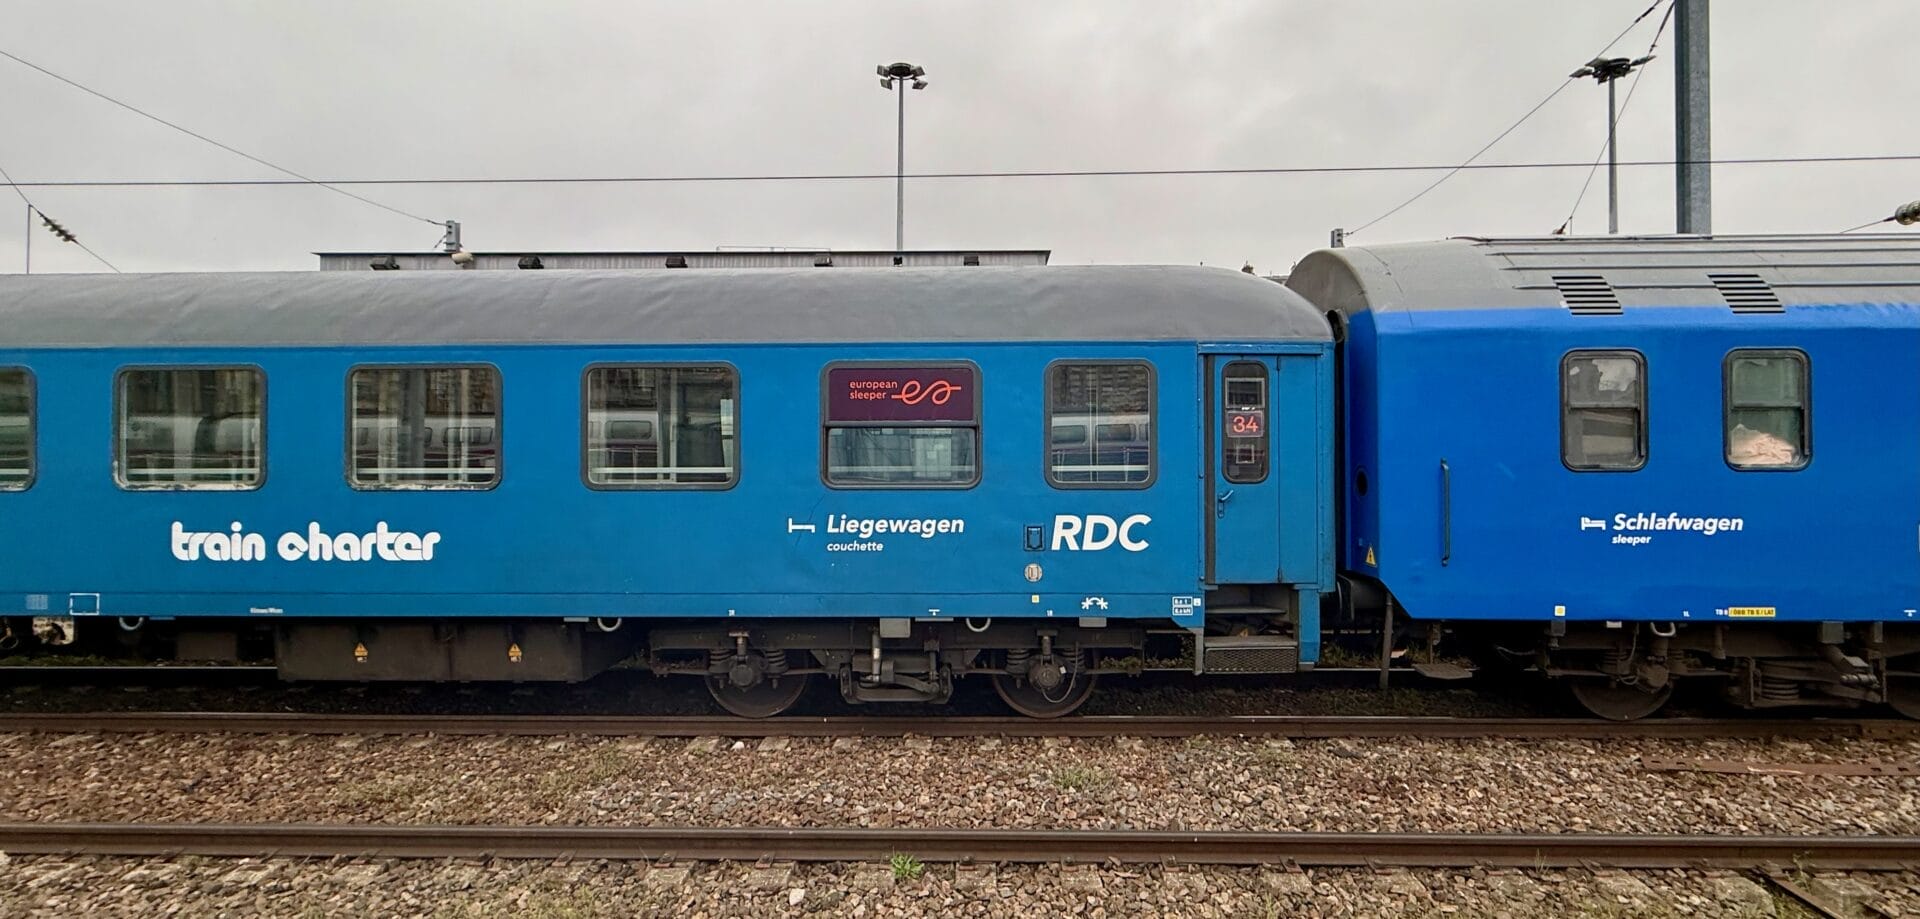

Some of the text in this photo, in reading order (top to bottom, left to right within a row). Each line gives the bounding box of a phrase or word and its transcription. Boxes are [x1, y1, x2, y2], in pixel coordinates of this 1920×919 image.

[849, 381, 898, 389] european
[849, 390, 887, 400] sleeper
[1233, 415, 1259, 433] 34
[827, 514, 965, 538] Liegewagen
[1613, 512, 1744, 535] Schlafwagen
[171, 521, 441, 561] train charter
[1051, 514, 1152, 552] RDC
[1612, 534, 1652, 546] sleeper
[827, 541, 884, 551] couchette
